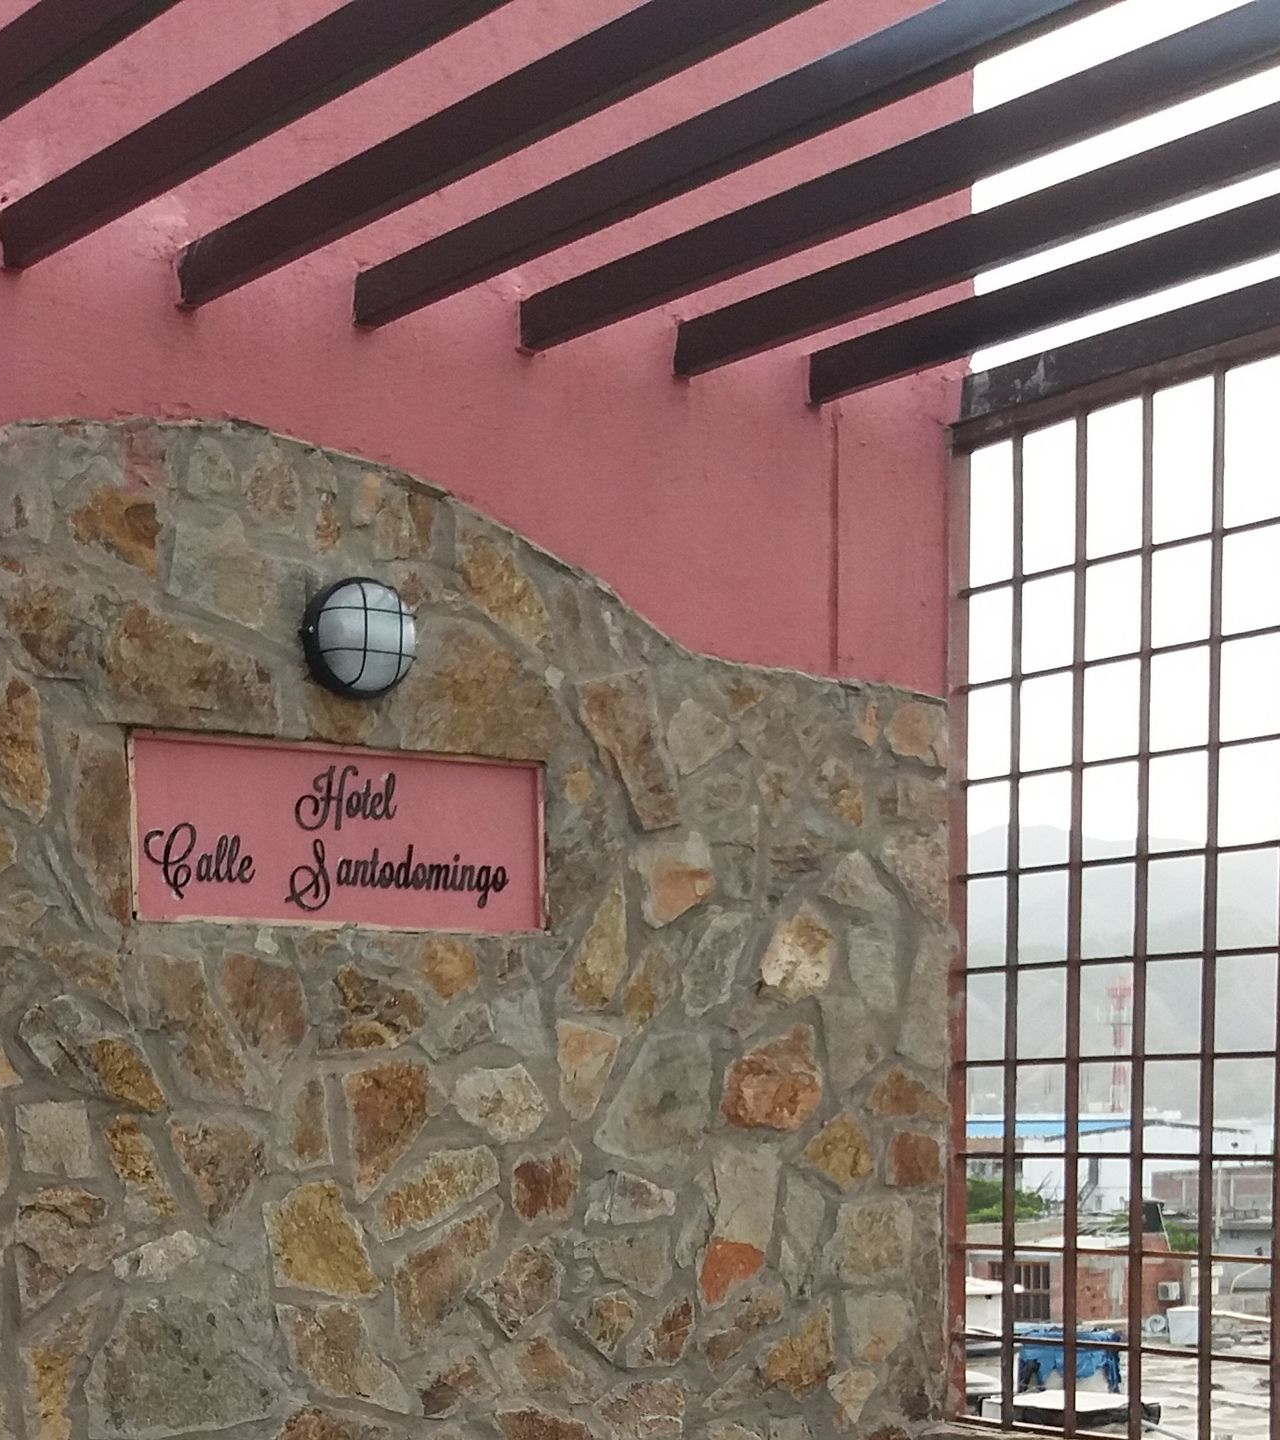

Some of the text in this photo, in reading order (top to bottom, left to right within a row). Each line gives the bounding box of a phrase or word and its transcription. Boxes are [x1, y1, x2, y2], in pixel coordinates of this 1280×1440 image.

[294, 765, 397, 831] Hotel
[143, 822, 509, 912] Calle Santodomingo
